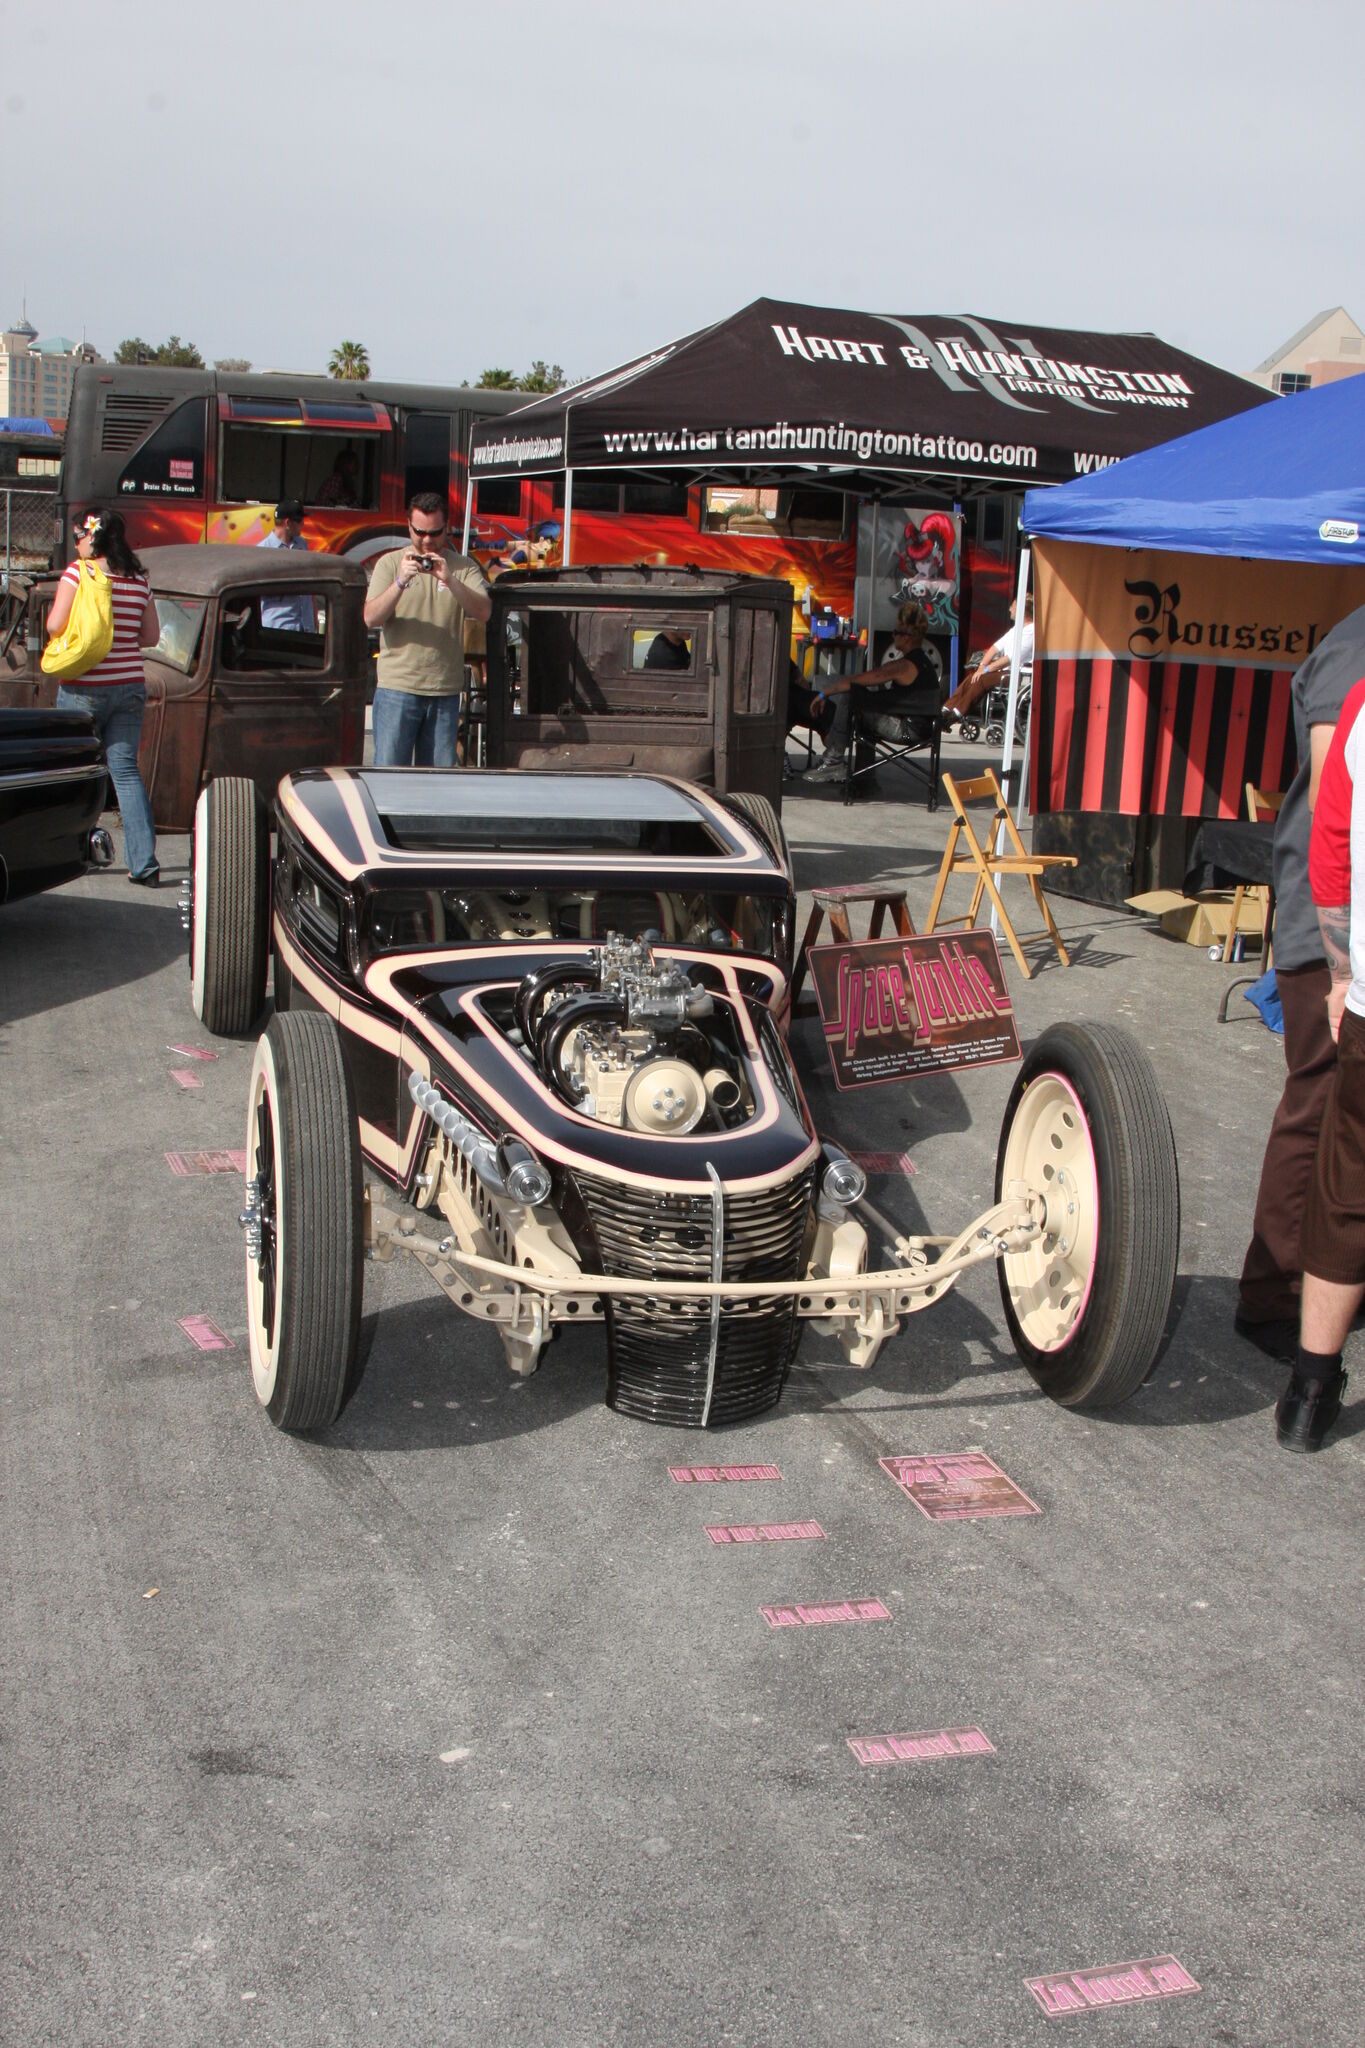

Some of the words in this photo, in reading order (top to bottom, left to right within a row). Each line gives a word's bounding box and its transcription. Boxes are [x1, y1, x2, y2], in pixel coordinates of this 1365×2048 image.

[771, 325, 889, 366] HART
[899, 346, 931, 370] &
[1000, 374, 1086, 399] TATTOO
[1090, 386, 1190, 409] COMPANY
[603, 422, 1037, 468] www.hartandhuntingtontattoo.com
[1073, 452, 1121, 474] ww
[1124, 578, 1330, 660] Roussel
[823, 953, 910, 1057] Space
[903, 941, 1014, 1046] Junkie
